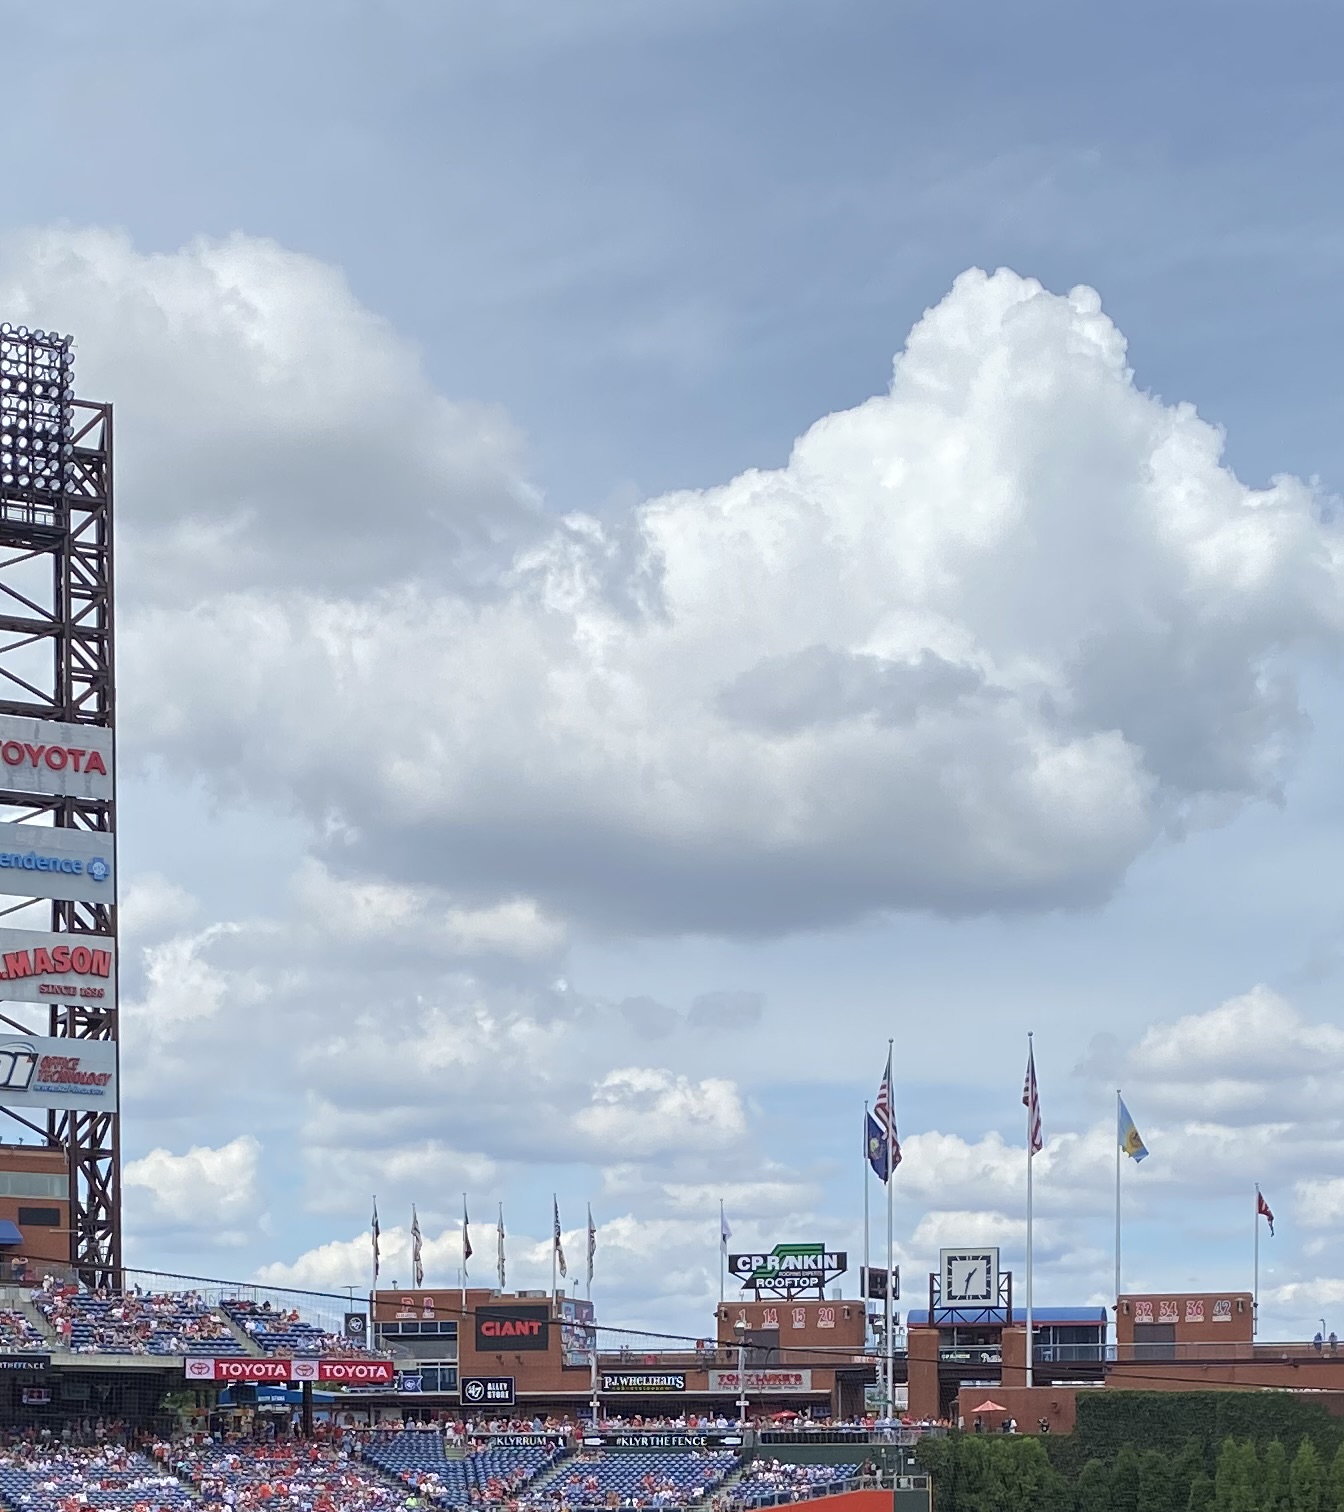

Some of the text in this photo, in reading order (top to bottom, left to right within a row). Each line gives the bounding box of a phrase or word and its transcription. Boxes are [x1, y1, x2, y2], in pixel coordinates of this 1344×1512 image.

[39, 984, 77, 996] SINCE
[767, 1254, 838, 1270] RANKIN
[756, 1278, 819, 1288] ROOFTOP
[819, 1308, 834, 1323] 20
[1135, 1301, 1232, 1317] 32 34 36 42
[480, 1320, 542, 1337] GIANT
[219, 1362, 288, 1377] TOYOTA
[323, 1363, 388, 1378] TOYOTA
[487, 1391, 509, 1399] STORE
